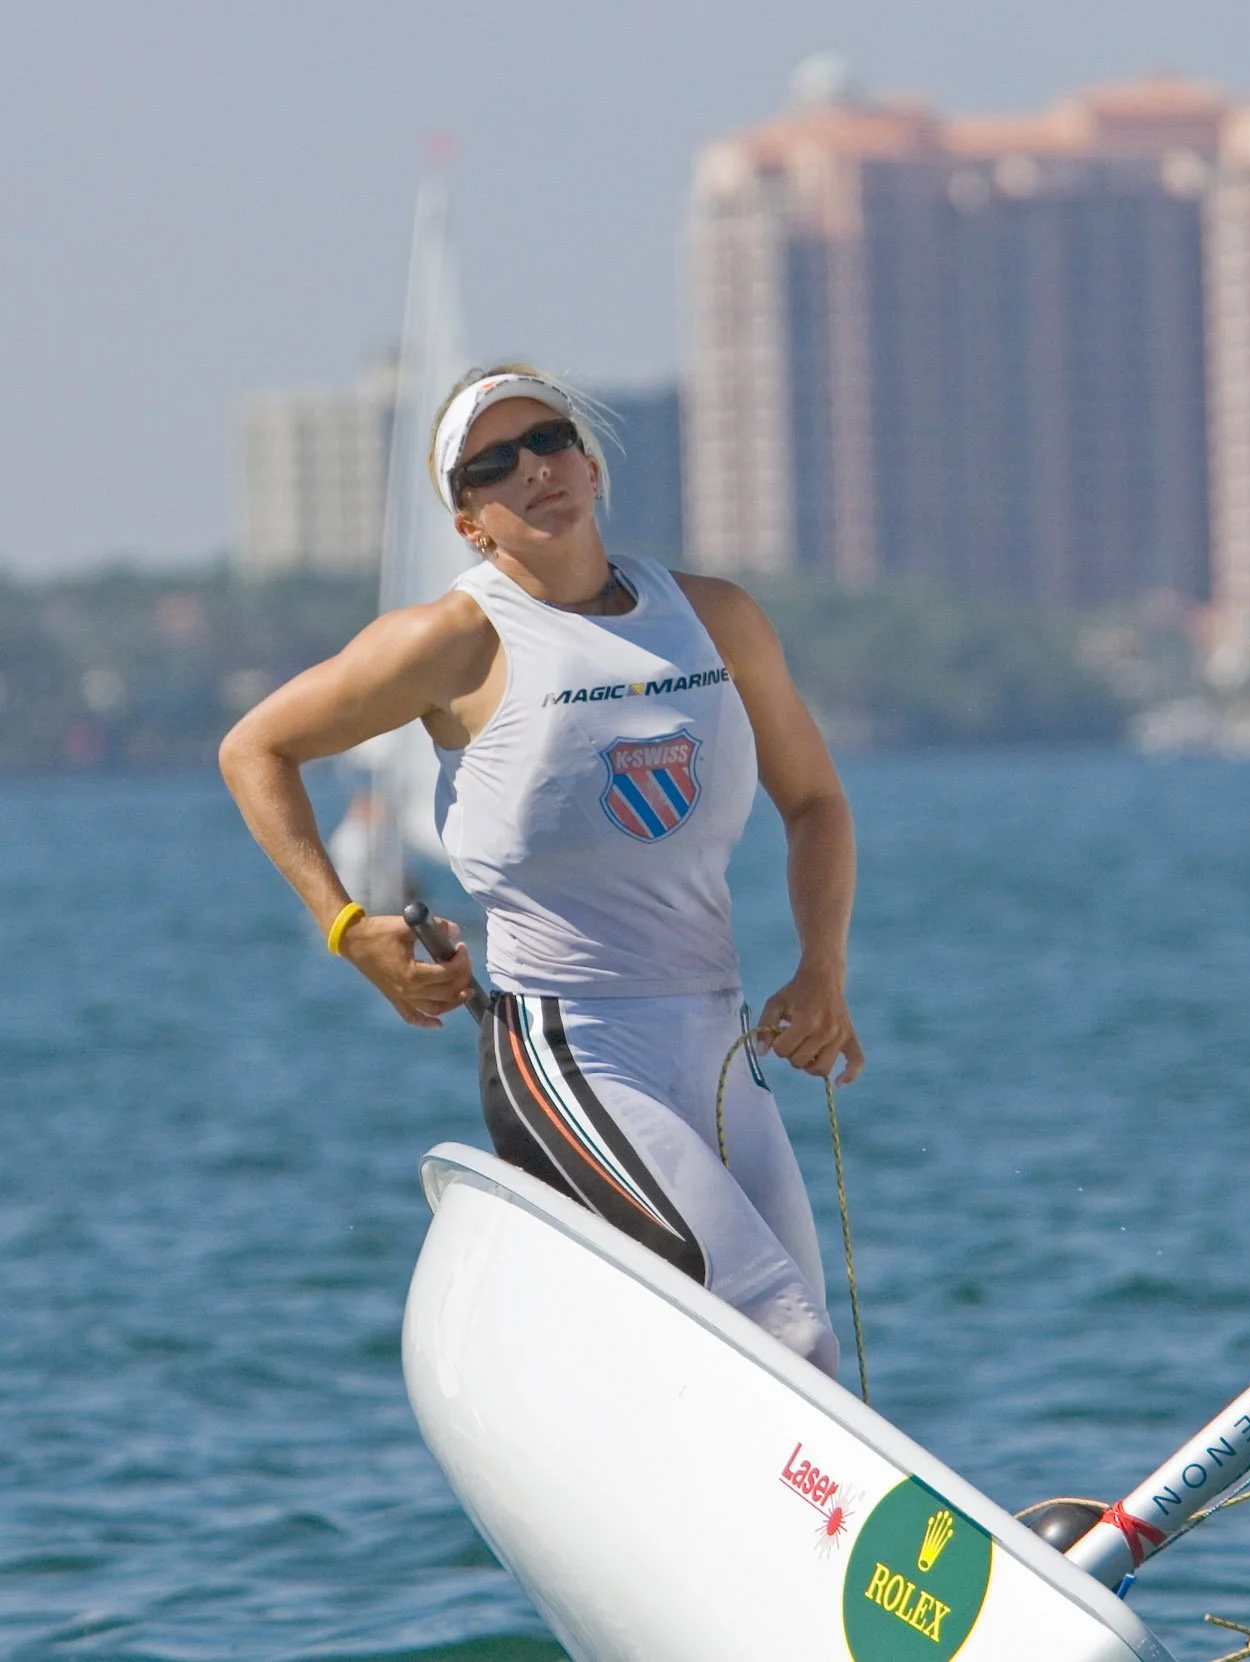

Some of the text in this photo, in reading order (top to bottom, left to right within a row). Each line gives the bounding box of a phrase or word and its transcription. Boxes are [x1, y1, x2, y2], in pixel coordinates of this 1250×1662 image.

[542, 667, 729, 708] MAGIC MARINE
[781, 1442, 840, 1507] Laser
[864, 1562, 951, 1643] ROLEX
